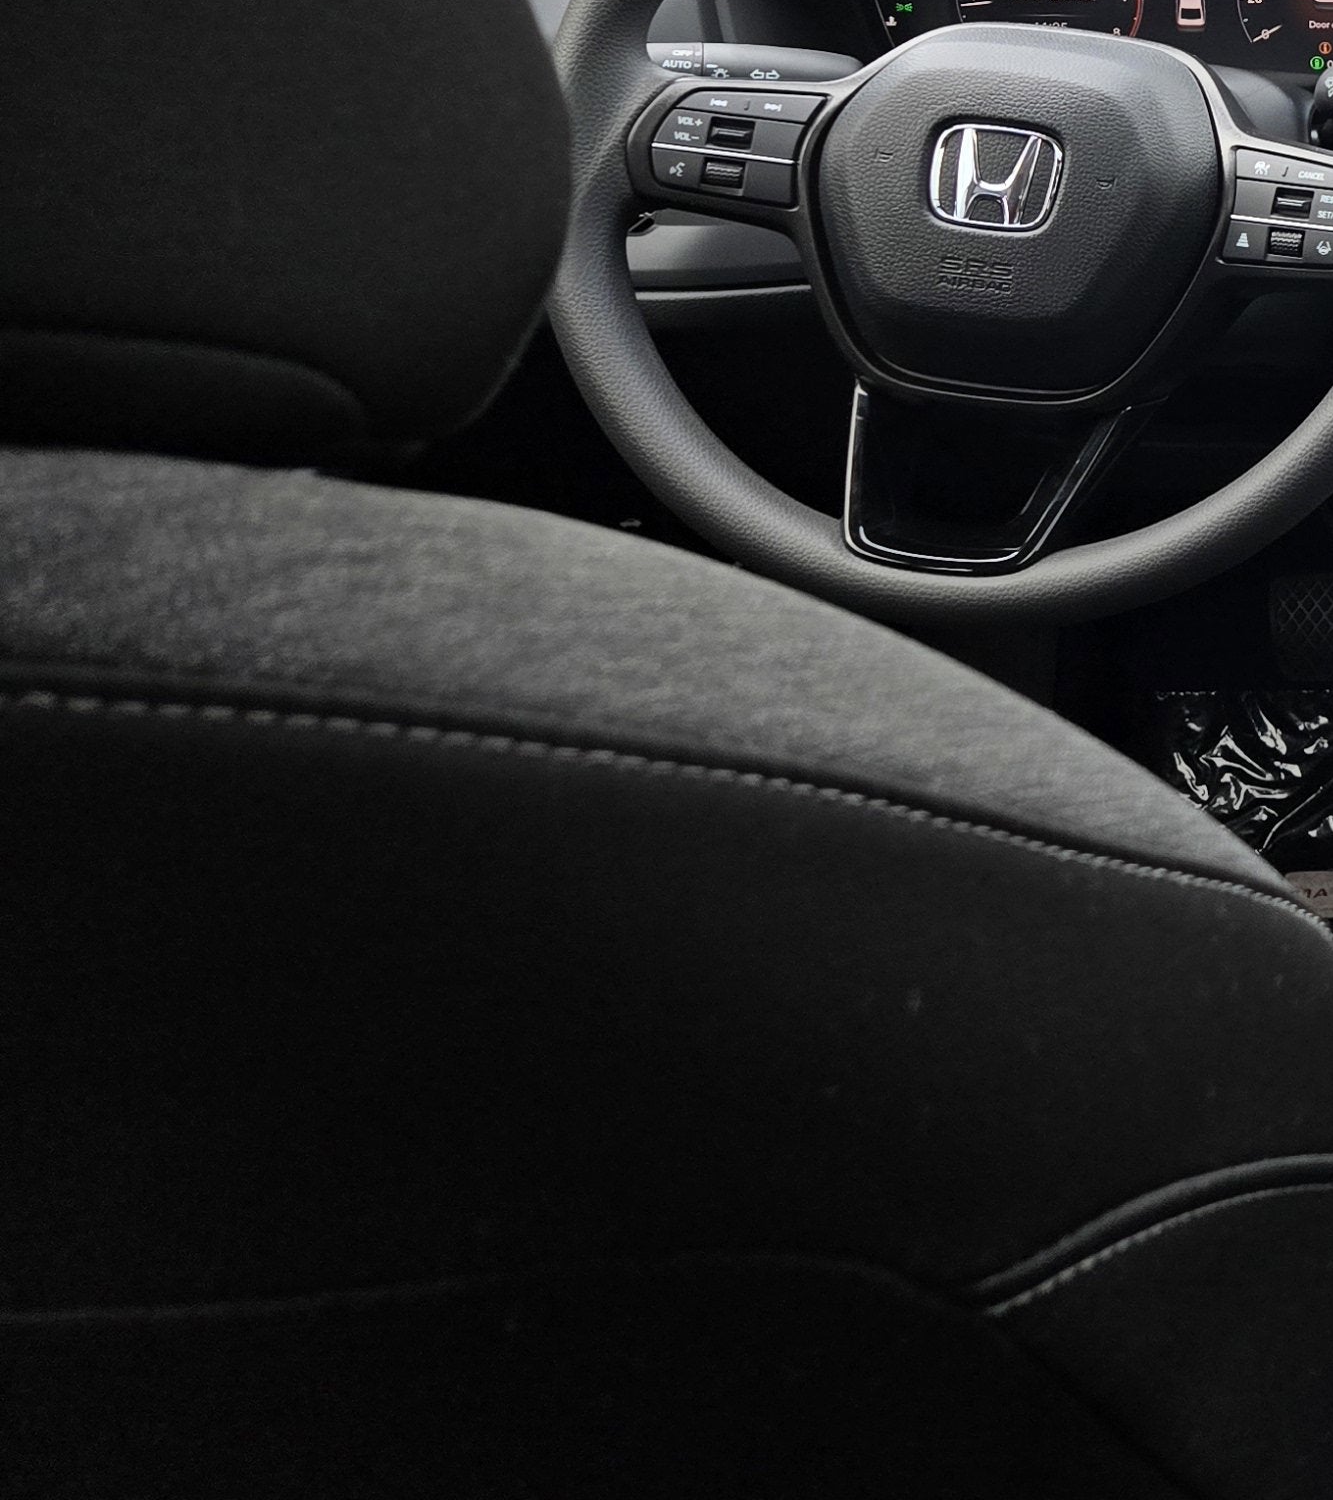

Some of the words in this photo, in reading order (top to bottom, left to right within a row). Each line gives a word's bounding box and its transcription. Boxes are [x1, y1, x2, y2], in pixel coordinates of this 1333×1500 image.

[1308, 20, 1330, 29] Door
[662, 59, 692, 69] AUTO
[1298, 171, 1325, 181] CANCEL
